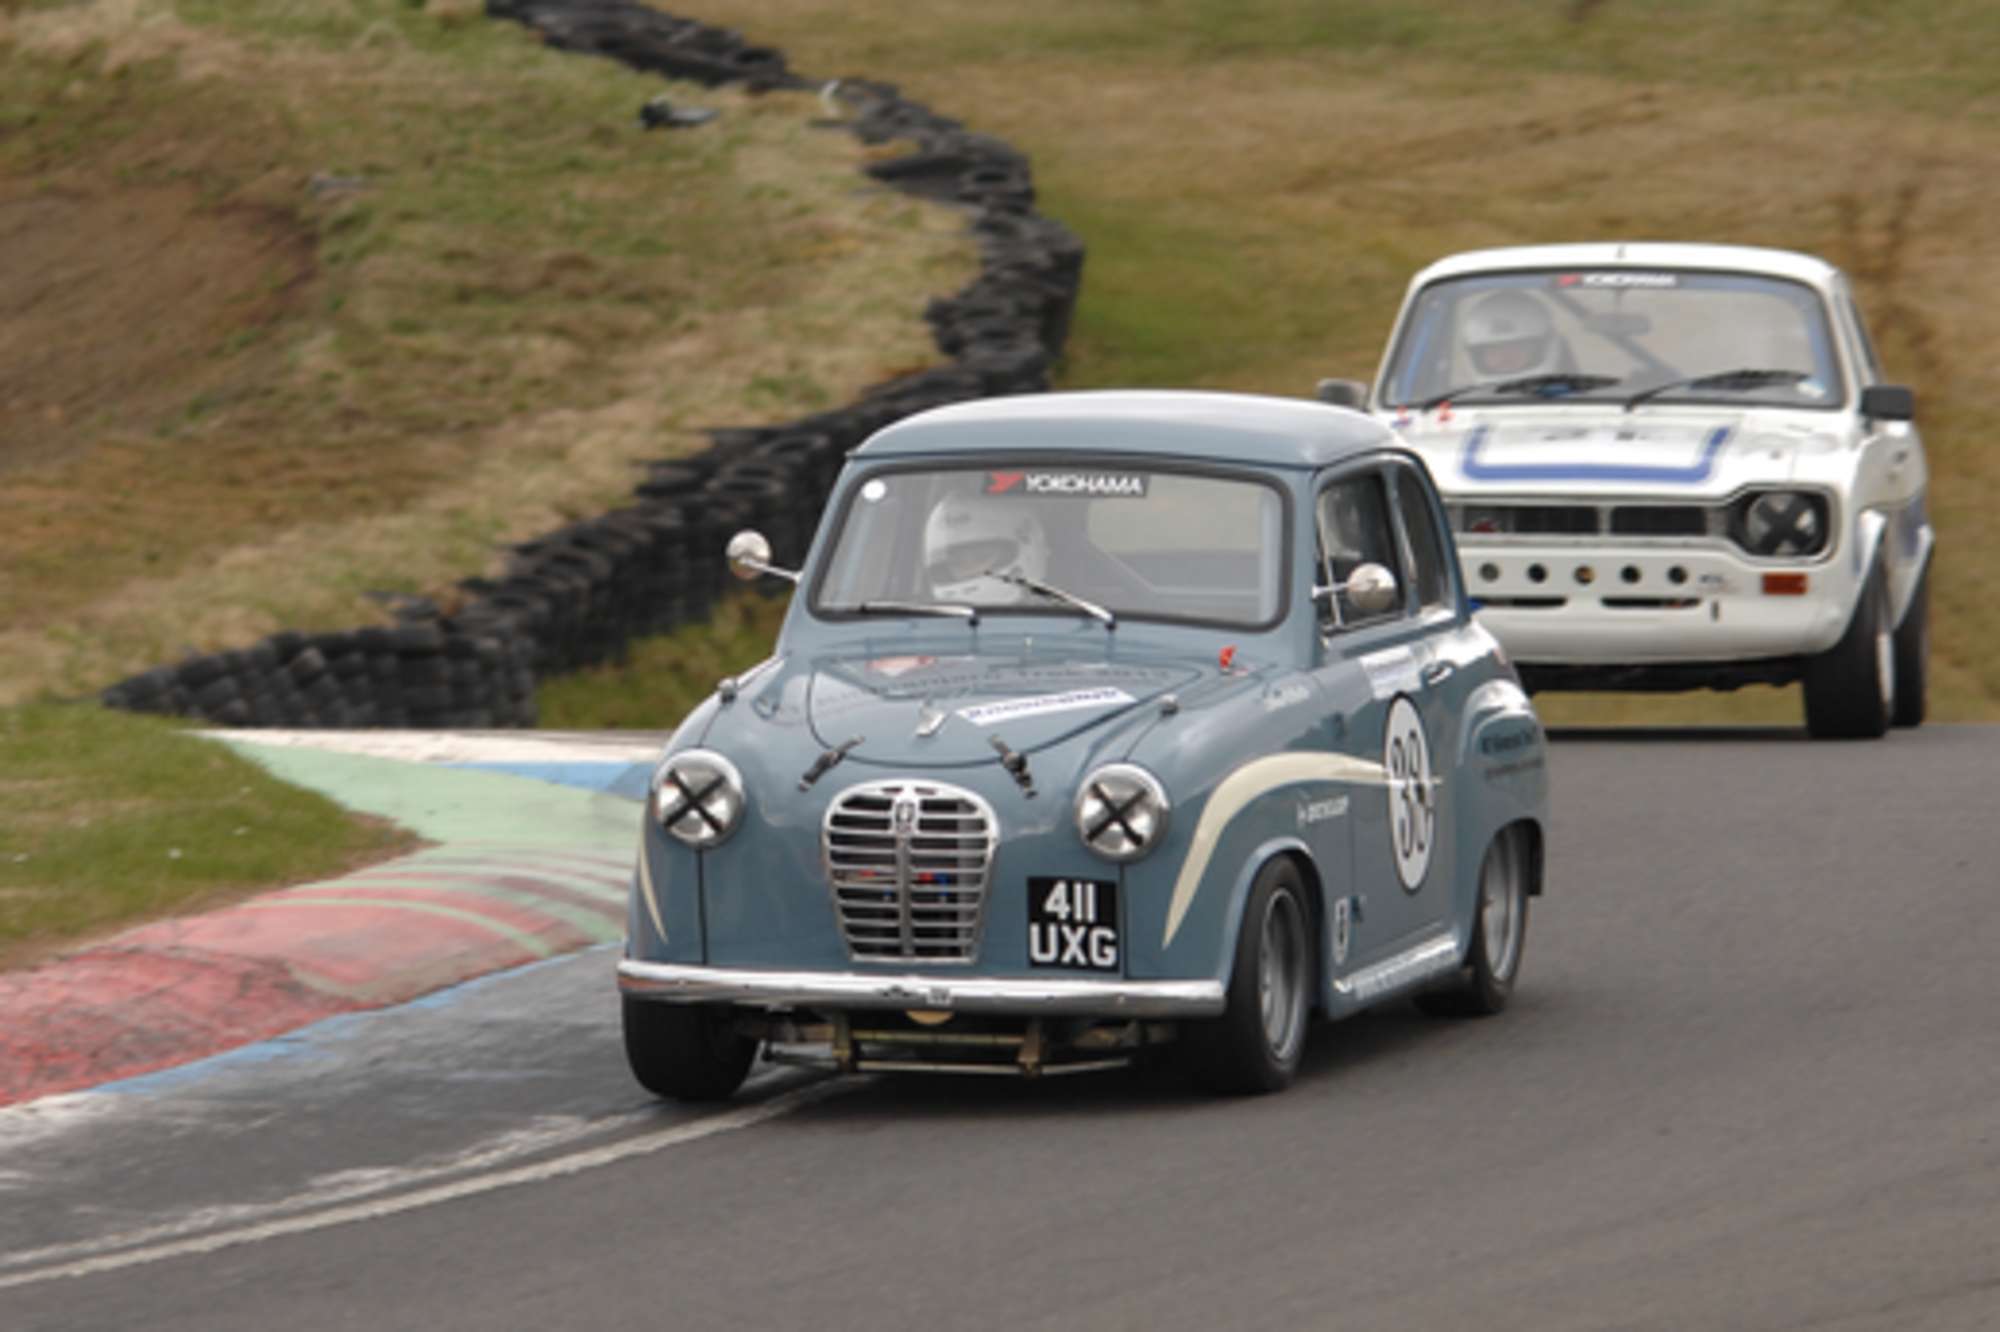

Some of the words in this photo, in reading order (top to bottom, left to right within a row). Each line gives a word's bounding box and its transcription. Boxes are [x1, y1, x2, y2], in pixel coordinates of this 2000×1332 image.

[1025, 473, 1144, 495] YOKOHAMA
[1044, 880, 1095, 922] 411
[1029, 922, 1117, 967] UXG
